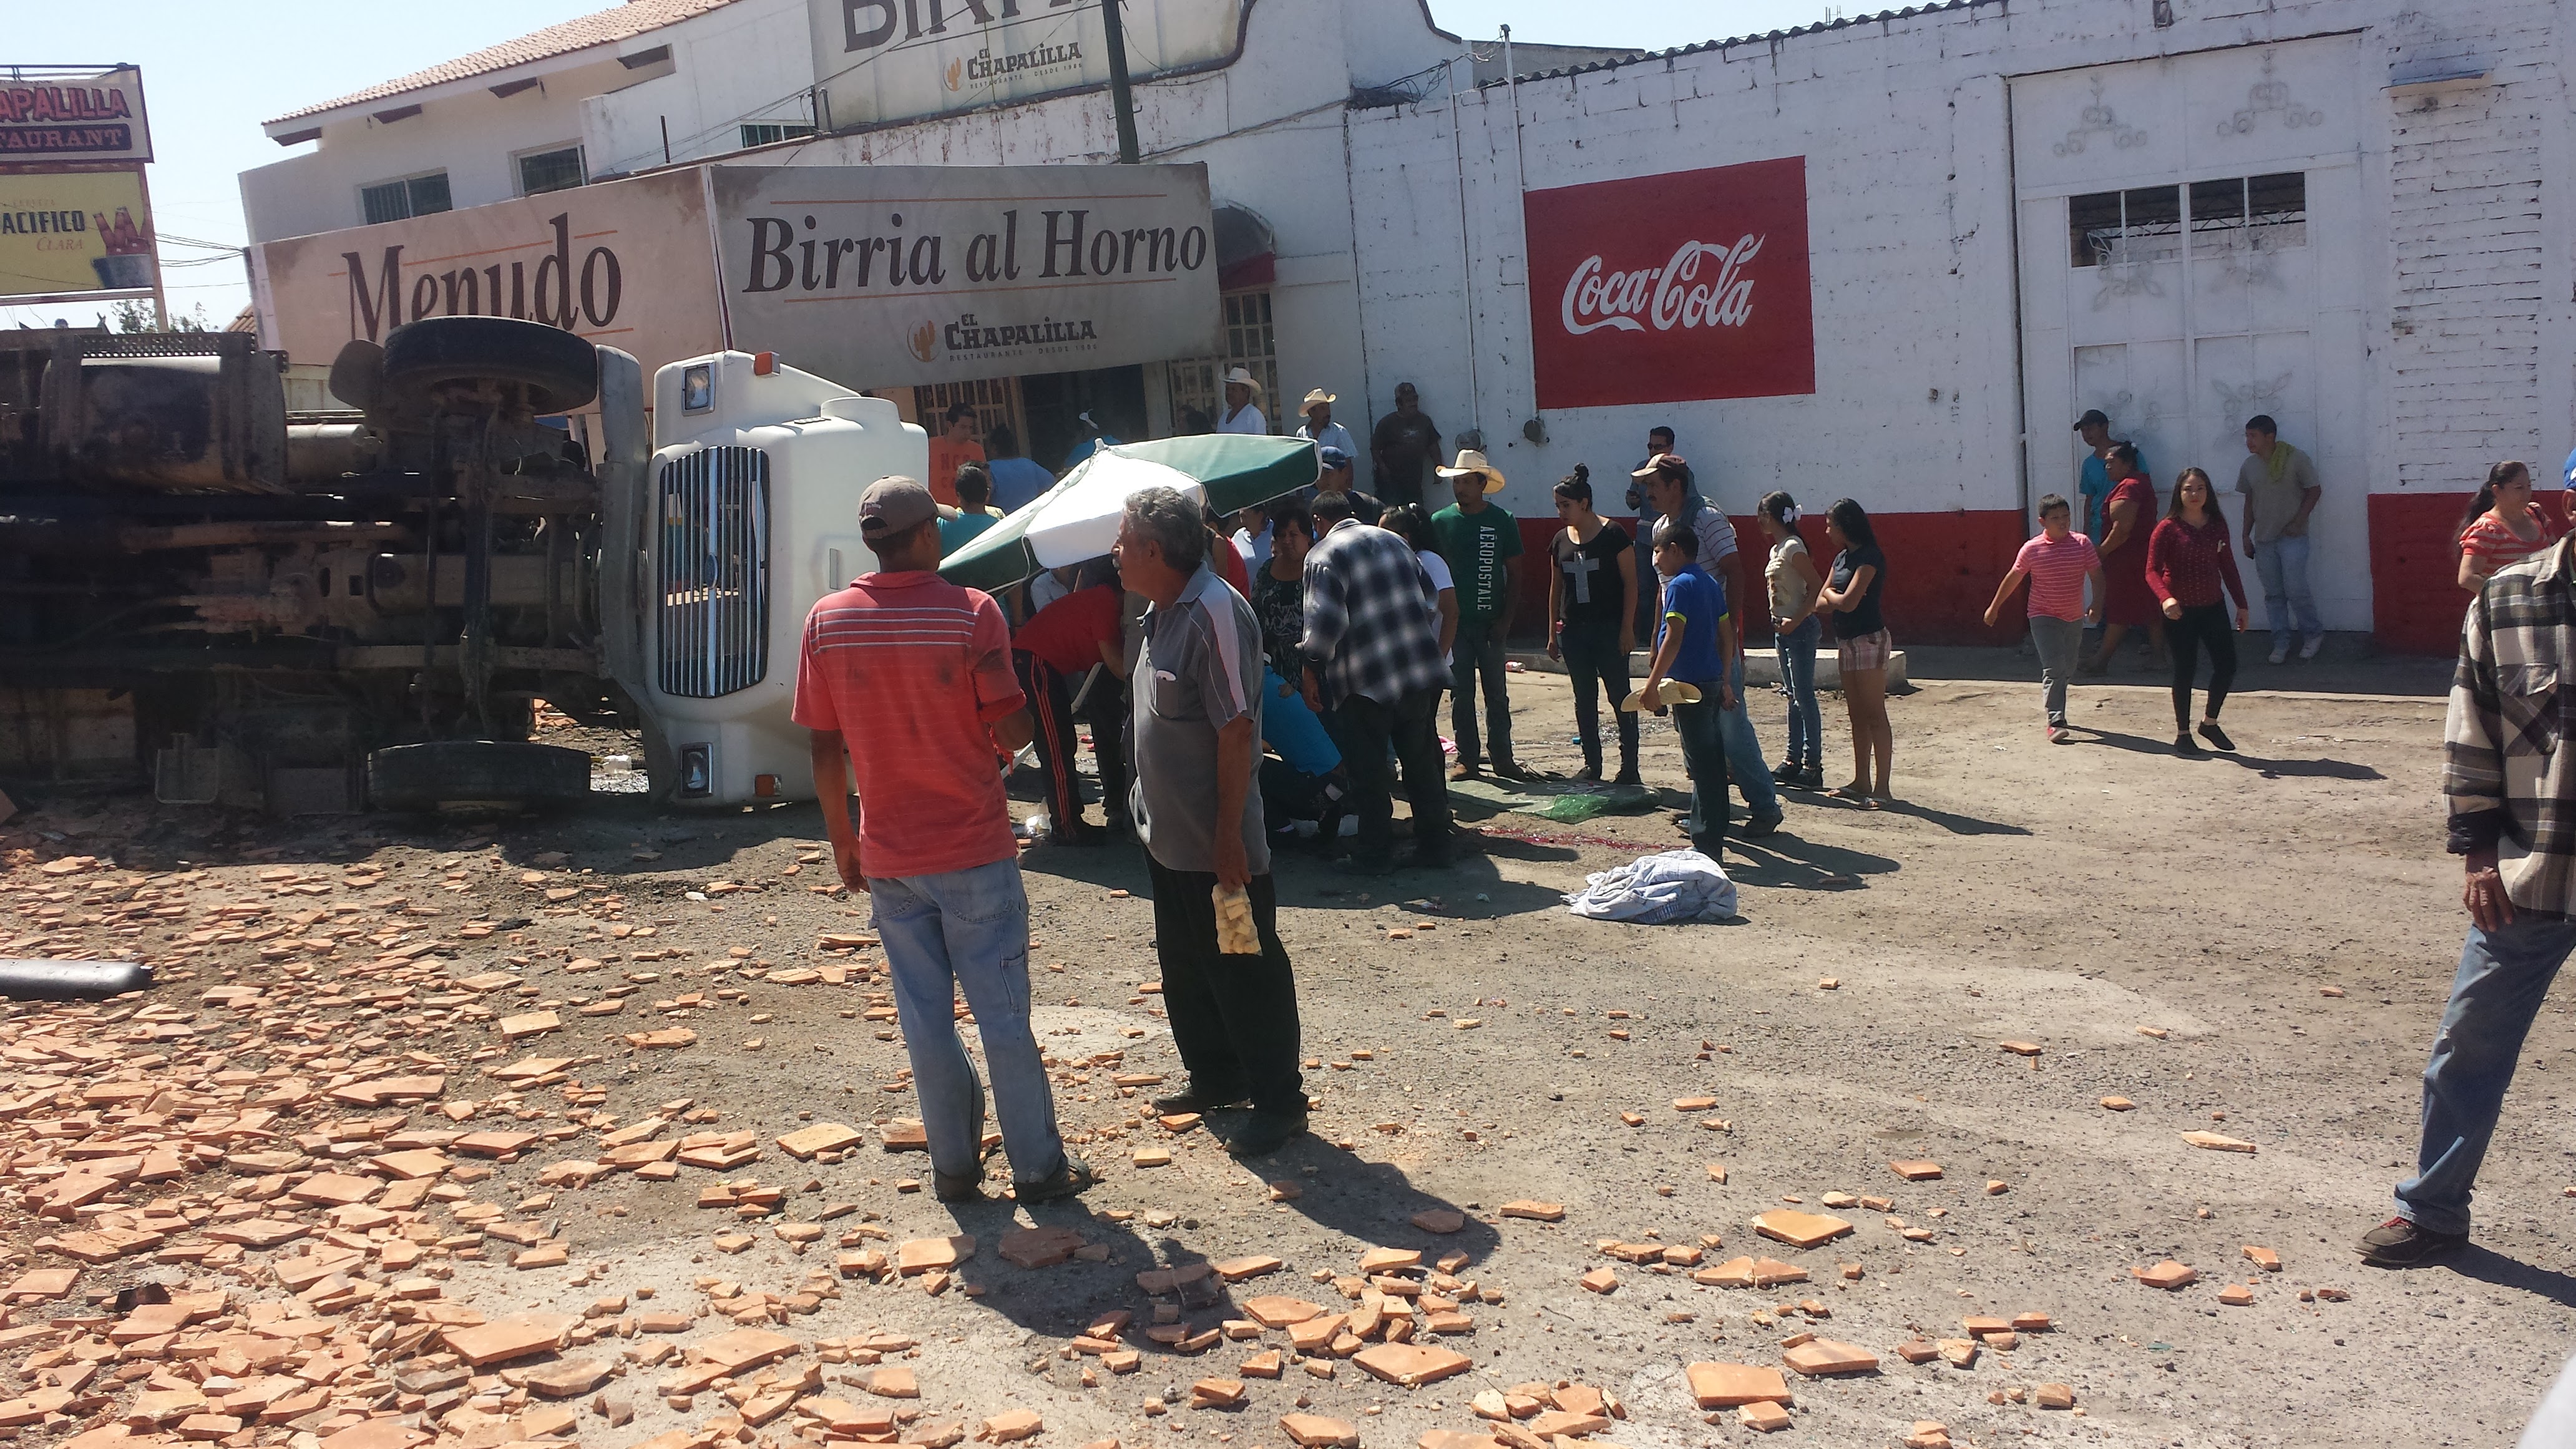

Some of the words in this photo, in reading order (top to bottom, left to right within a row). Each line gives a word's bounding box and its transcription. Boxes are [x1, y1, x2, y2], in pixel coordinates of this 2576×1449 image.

[967, 42, 1083, 80] CHAPALILLA
[979, 48, 990, 59] EL
[970, 74, 1023, 90] RESTAURANTE
[1035, 67, 1059, 77] DESDE
[36, 237, 84, 251] CLARA
[742, 214, 946, 293] Birria
[965, 209, 1020, 283] al
[1038, 209, 1207, 280] Horno
[341, 212, 622, 341] Menudo
[961, 313, 978, 327] EL
[944, 316, 1097, 351] CHAPALILLA
[949, 350, 1023, 362] RESTAURANTE
[1038, 346, 1070, 354] DESDE
